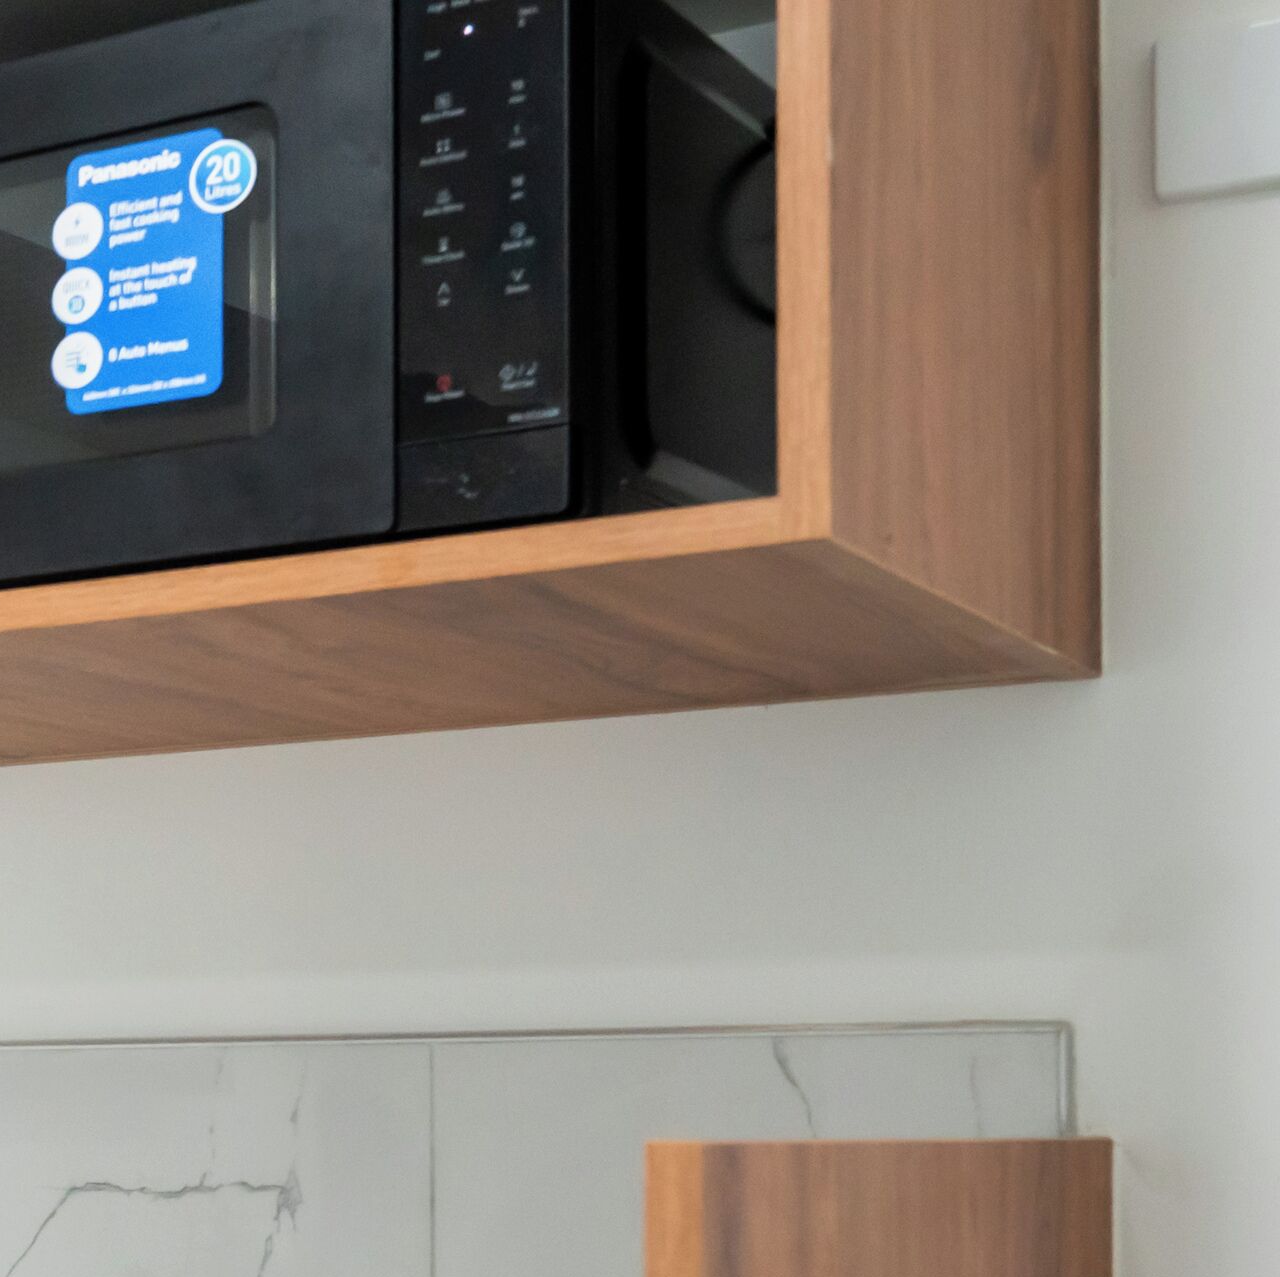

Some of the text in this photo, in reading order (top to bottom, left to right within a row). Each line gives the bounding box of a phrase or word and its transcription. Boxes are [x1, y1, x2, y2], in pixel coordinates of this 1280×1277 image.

[78, 149, 181, 187] Panasonic
[206, 151, 240, 185] 20
[109, 190, 183, 218] Efficient and
[204, 183, 241, 200] Litres
[109, 208, 180, 232] fast cooking
[109, 228, 146, 249] power
[109, 256, 197, 283] Instant heating
[109, 267, 193, 297] at the touch of
[119, 293, 158, 311] button
[118, 345, 147, 361] Auto
[147, 338, 189, 356] Menus
